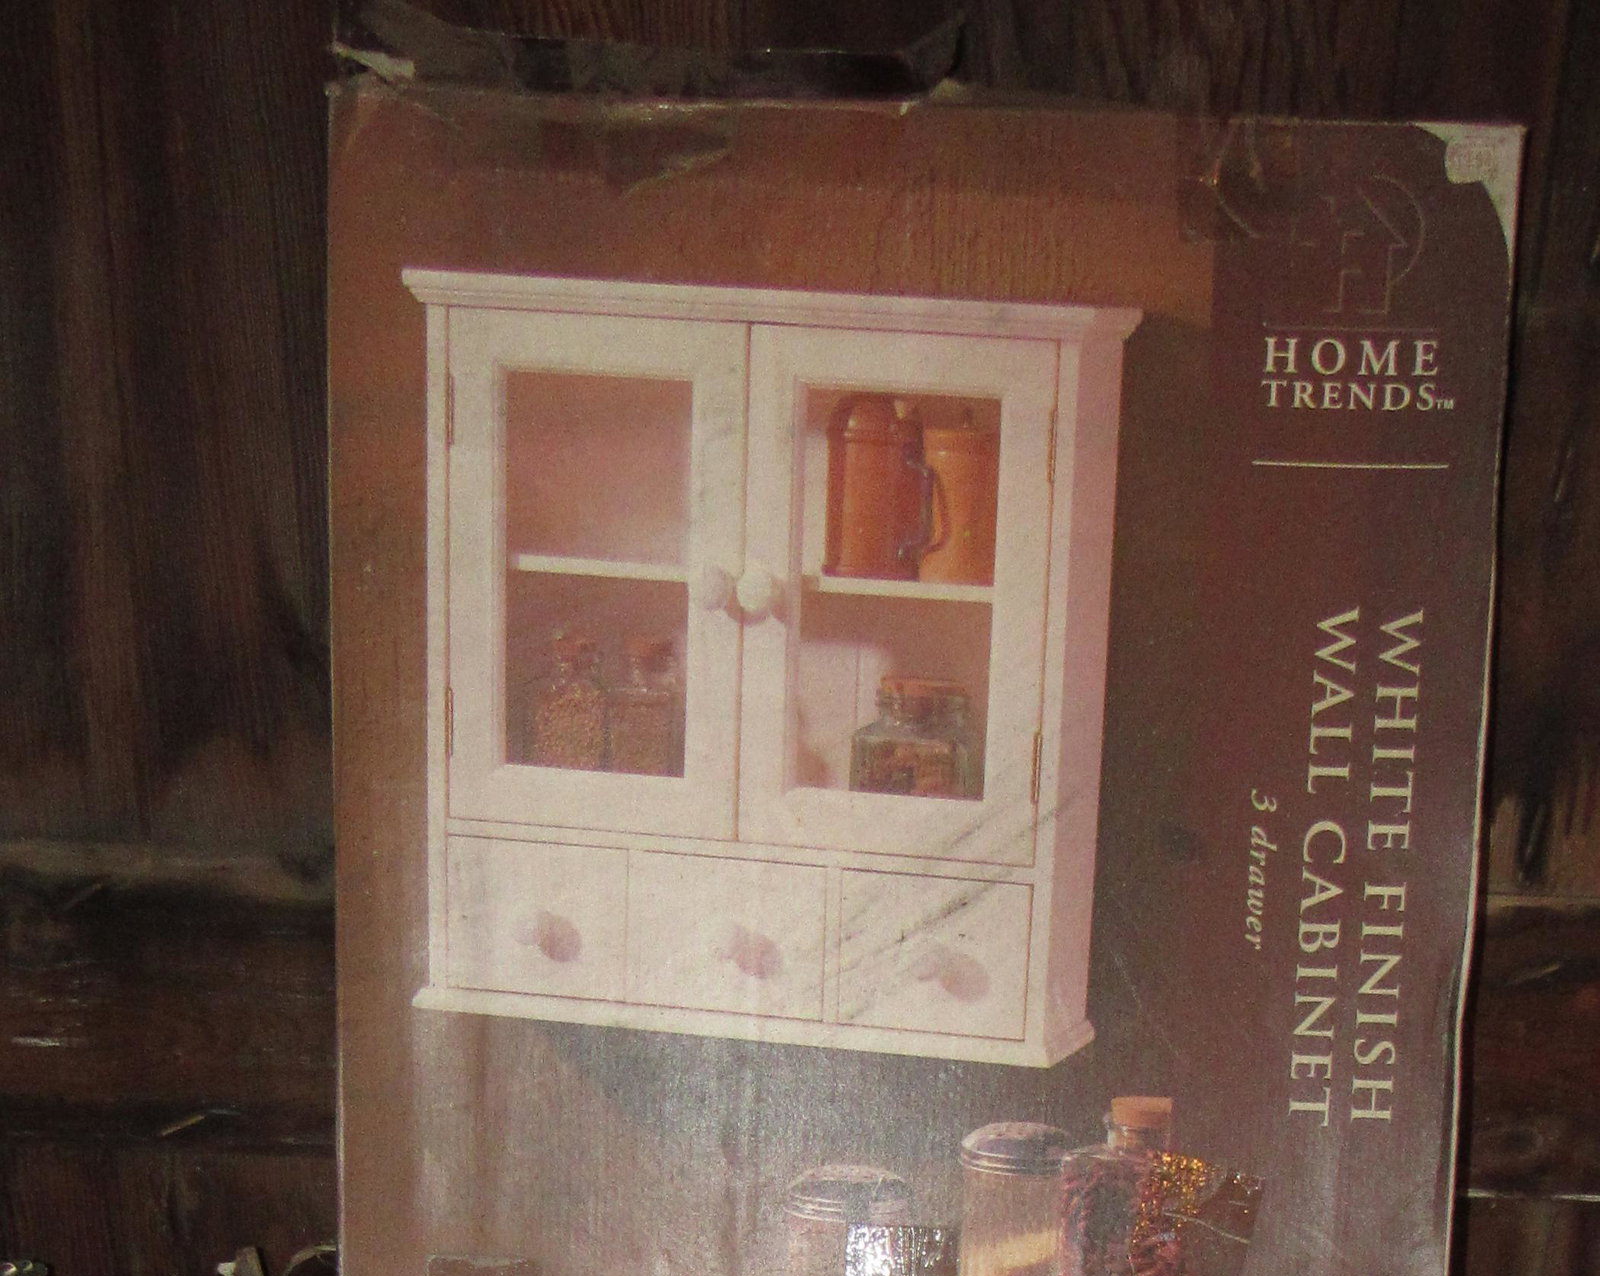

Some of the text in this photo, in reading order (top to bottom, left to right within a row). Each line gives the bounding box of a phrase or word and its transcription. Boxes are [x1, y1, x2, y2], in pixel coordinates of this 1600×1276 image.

[1262, 337, 1438, 377] HOME
[1246, 788, 1277, 950] 3 drawer
[1288, 606, 1360, 1127] WALL CABINET
[1351, 608, 1423, 1123] WHITE FINISH
